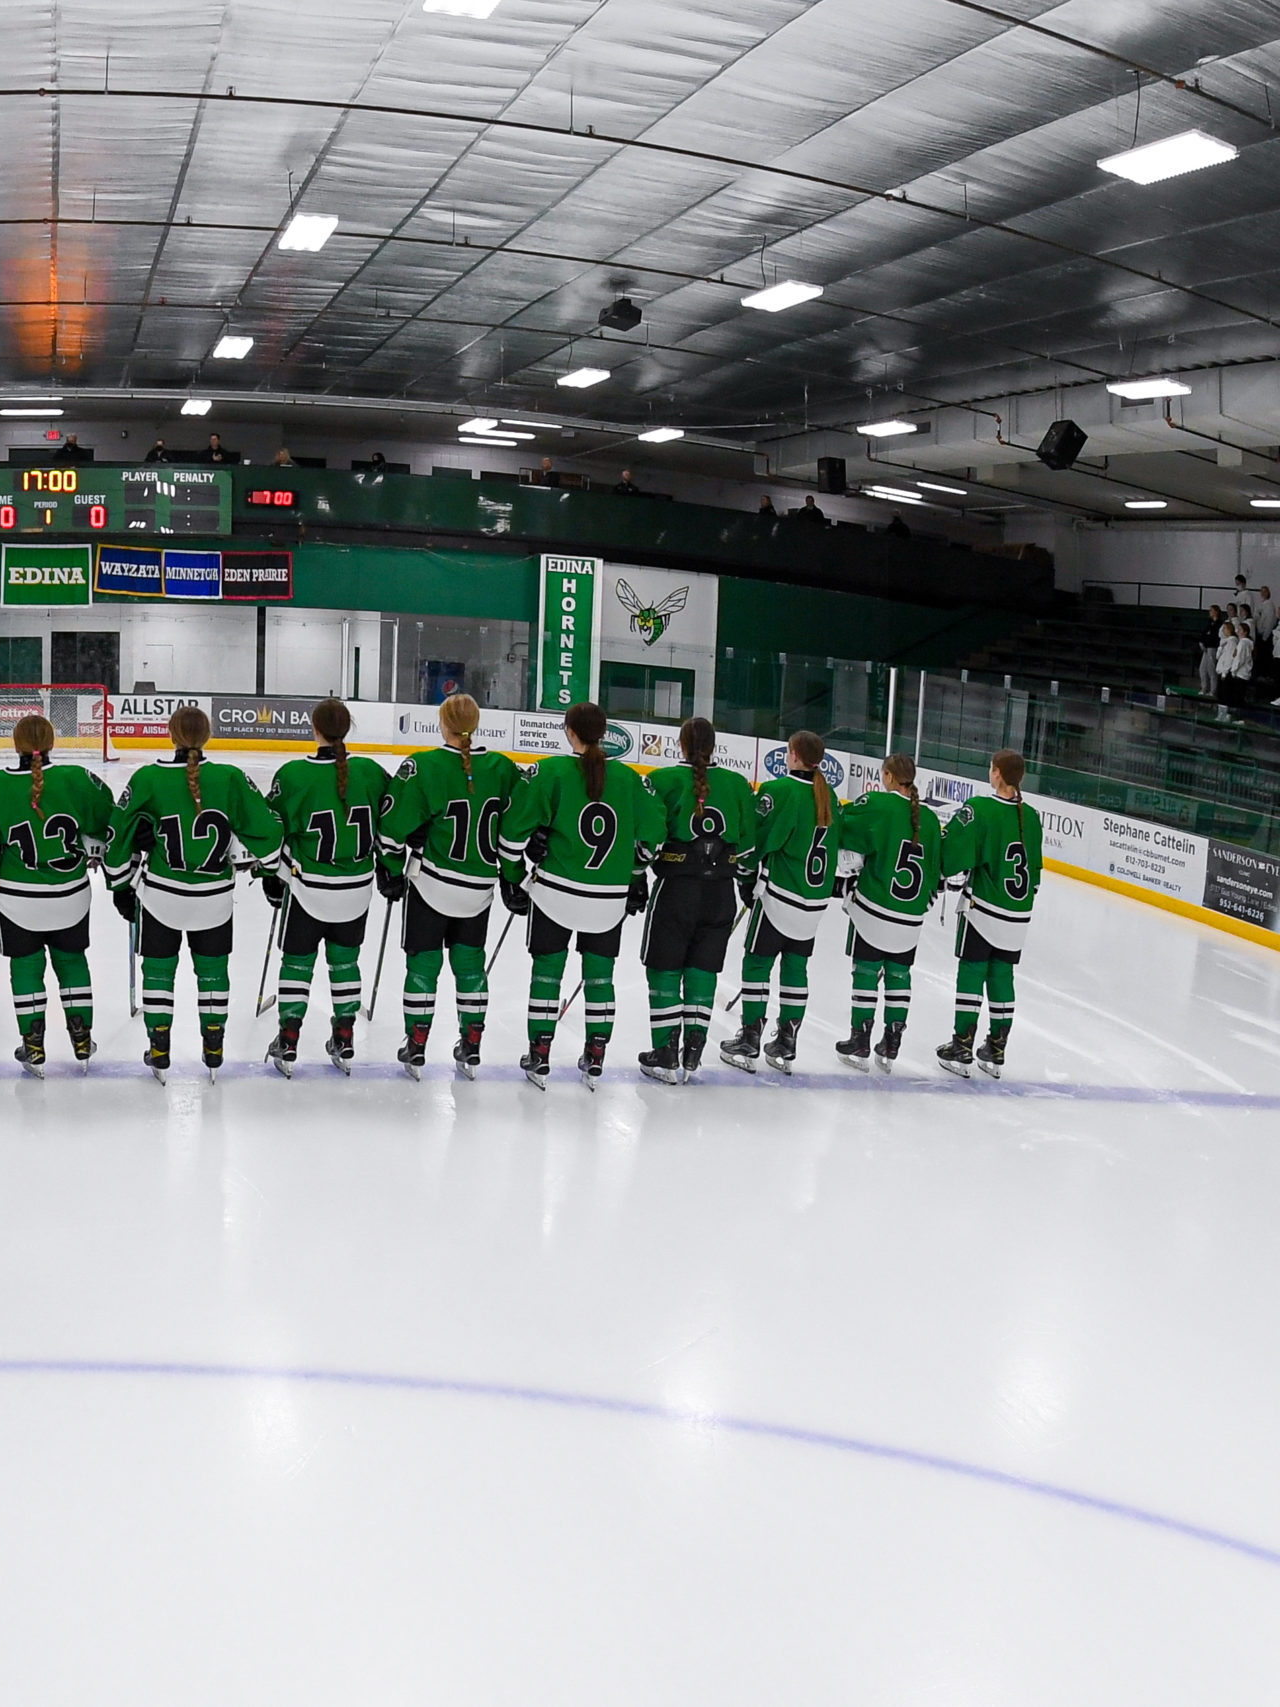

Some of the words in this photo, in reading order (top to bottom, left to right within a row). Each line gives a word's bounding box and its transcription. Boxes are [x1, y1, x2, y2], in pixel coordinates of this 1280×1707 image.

[23, 470, 77, 492] 17:00
[122, 472, 158, 482] PLAYER
[174, 473, 215, 483] PENALTY
[34, 501, 58, 509] PERIOD
[74, 495, 106, 505] GUEST
[0, 505, 16, 528] 0
[45, 509, 52, 525] 1
[90, 505, 106, 528] 0
[8, 567, 86, 584] EDINA
[100, 561, 160, 578] WAYZATA
[224, 568, 250, 581] EDEN
[252, 568, 288, 581] PRAIRIE
[547, 558, 593, 575] EDINA
[557, 577, 578, 705] HORNETS
[520, 719, 565, 730] Unmatched
[520, 730, 547, 739] service
[520, 738, 538, 748] since
[935, 776, 974, 803] WINNESOTA
[7, 813, 86, 872] 13
[158, 808, 232, 875] 12
[307, 805, 373, 865] 11
[444, 797, 501, 866] 10
[578, 801, 618, 870] 9
[1104, 817, 1150, 843] Stephane
[1154, 831, 1195, 855] Cattelin
[805, 826, 829, 887] 6
[1213, 847, 1257, 869] SANDERSON
[890, 839, 925, 901] 5
[1004, 842, 1030, 900] 3
